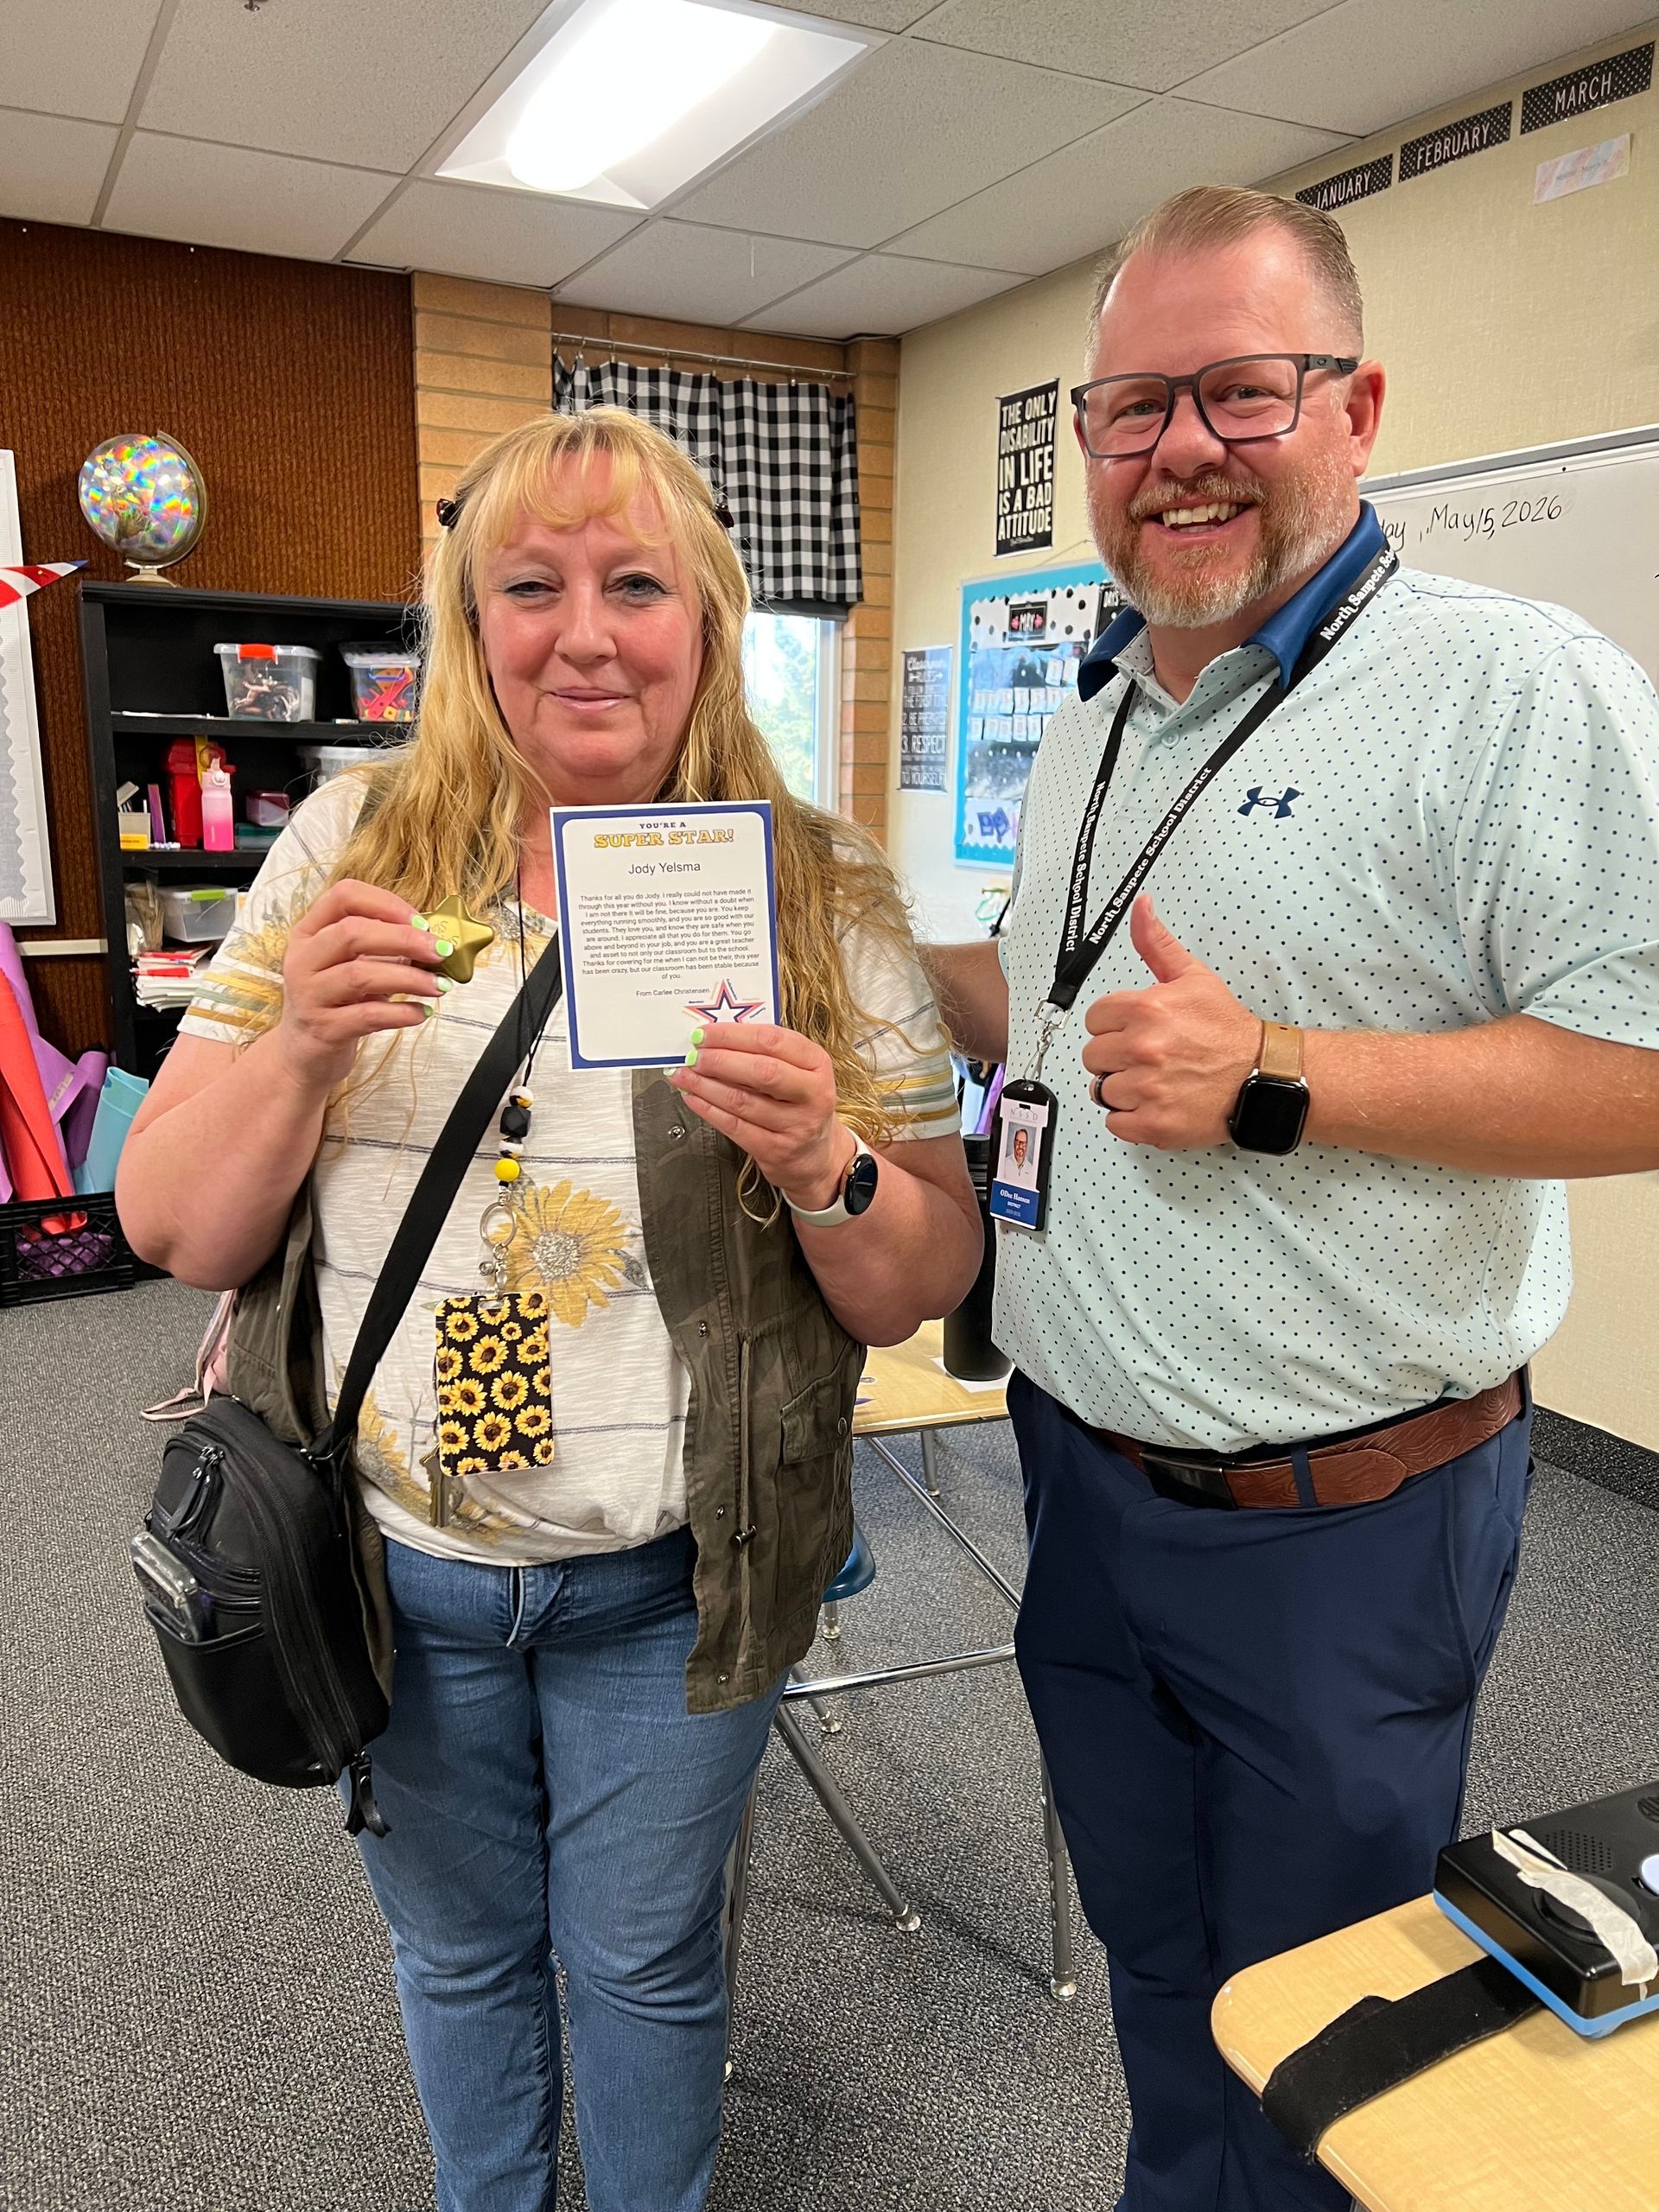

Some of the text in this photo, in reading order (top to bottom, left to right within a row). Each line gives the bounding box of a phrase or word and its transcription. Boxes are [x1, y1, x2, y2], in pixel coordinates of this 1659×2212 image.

[1555, 72, 1612, 113] MARCH
[1416, 123, 1491, 169] FEBRUARY
[1313, 170, 1370, 209] JANUARY
[1001, 391, 1057, 428] THE ONLY
[1001, 416, 1054, 454] DISABILITY
[999, 445, 1053, 491] IN LIFE
[999, 482, 1052, 515] IS A BAD
[998, 506, 1052, 541] ATTITUDE
[1429, 503, 1474, 542] May
[1501, 495, 1562, 528] 2026
[1019, 613, 1035, 632] MAY
[1320, 606, 1358, 641] North
[1348, 566, 1385, 606] Sanpete
[912, 735, 946, 753] RESPECT
[594, 829, 734, 848] SUPER STAR!
[1089, 767, 1212, 944] North Sanpete School District
[629, 862, 701, 875] Jody Yelsma
[1065, 780, 1106, 952] North Sanpete School District
